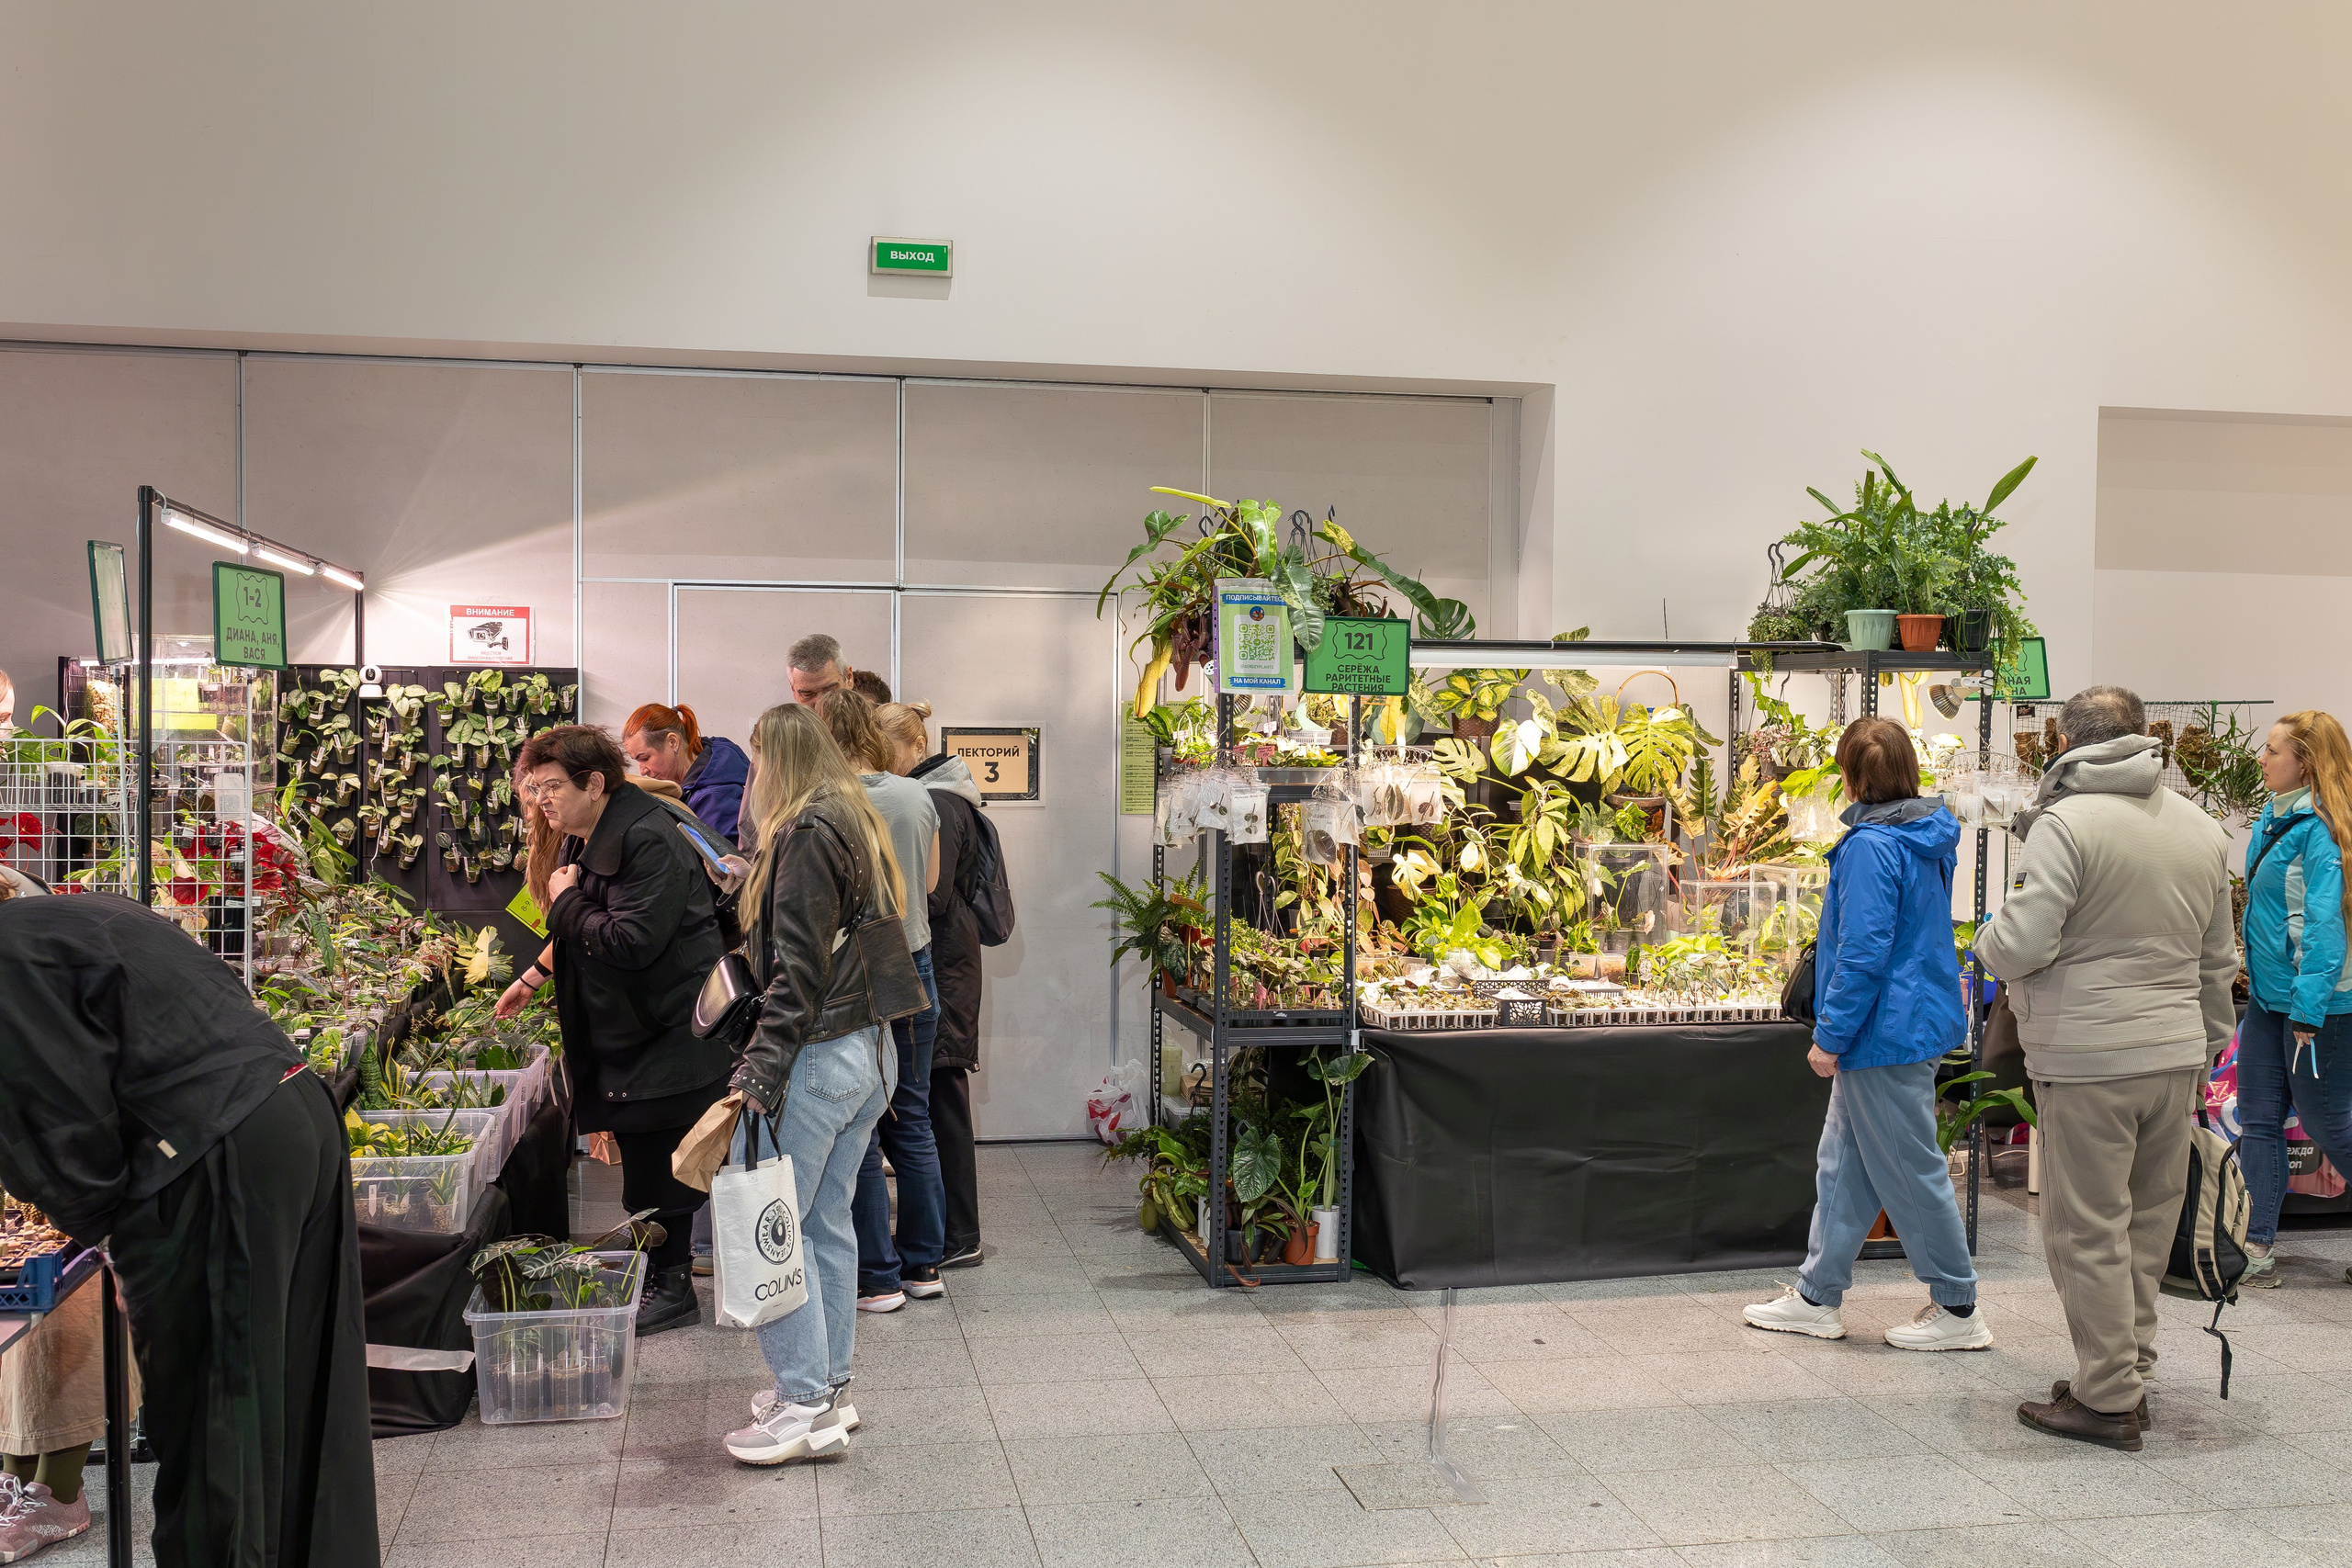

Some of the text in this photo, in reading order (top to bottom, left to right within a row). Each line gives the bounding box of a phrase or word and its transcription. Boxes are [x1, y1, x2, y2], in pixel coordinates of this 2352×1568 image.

[890, 250, 934, 263] ВЫХОД
[243, 586, 262, 608] 1-2
[466, 608, 514, 616] ВНИМАНИЕ
[226, 626, 280, 649] ДИАНА, АНЯ,
[1344, 632, 1374, 650] 121
[243, 646, 266, 661] ВАСЯ
[1337, 663, 1380, 674] СЕРЁЖА
[1325, 673, 1391, 684] РАРИТЕТНЫЕ
[1331, 682, 1385, 693] РАСТЕНИЯ
[984, 761, 1000, 783] 3
[2287, 1146, 2314, 1156] ежда
[754, 1268, 803, 1302] COLIN'S
